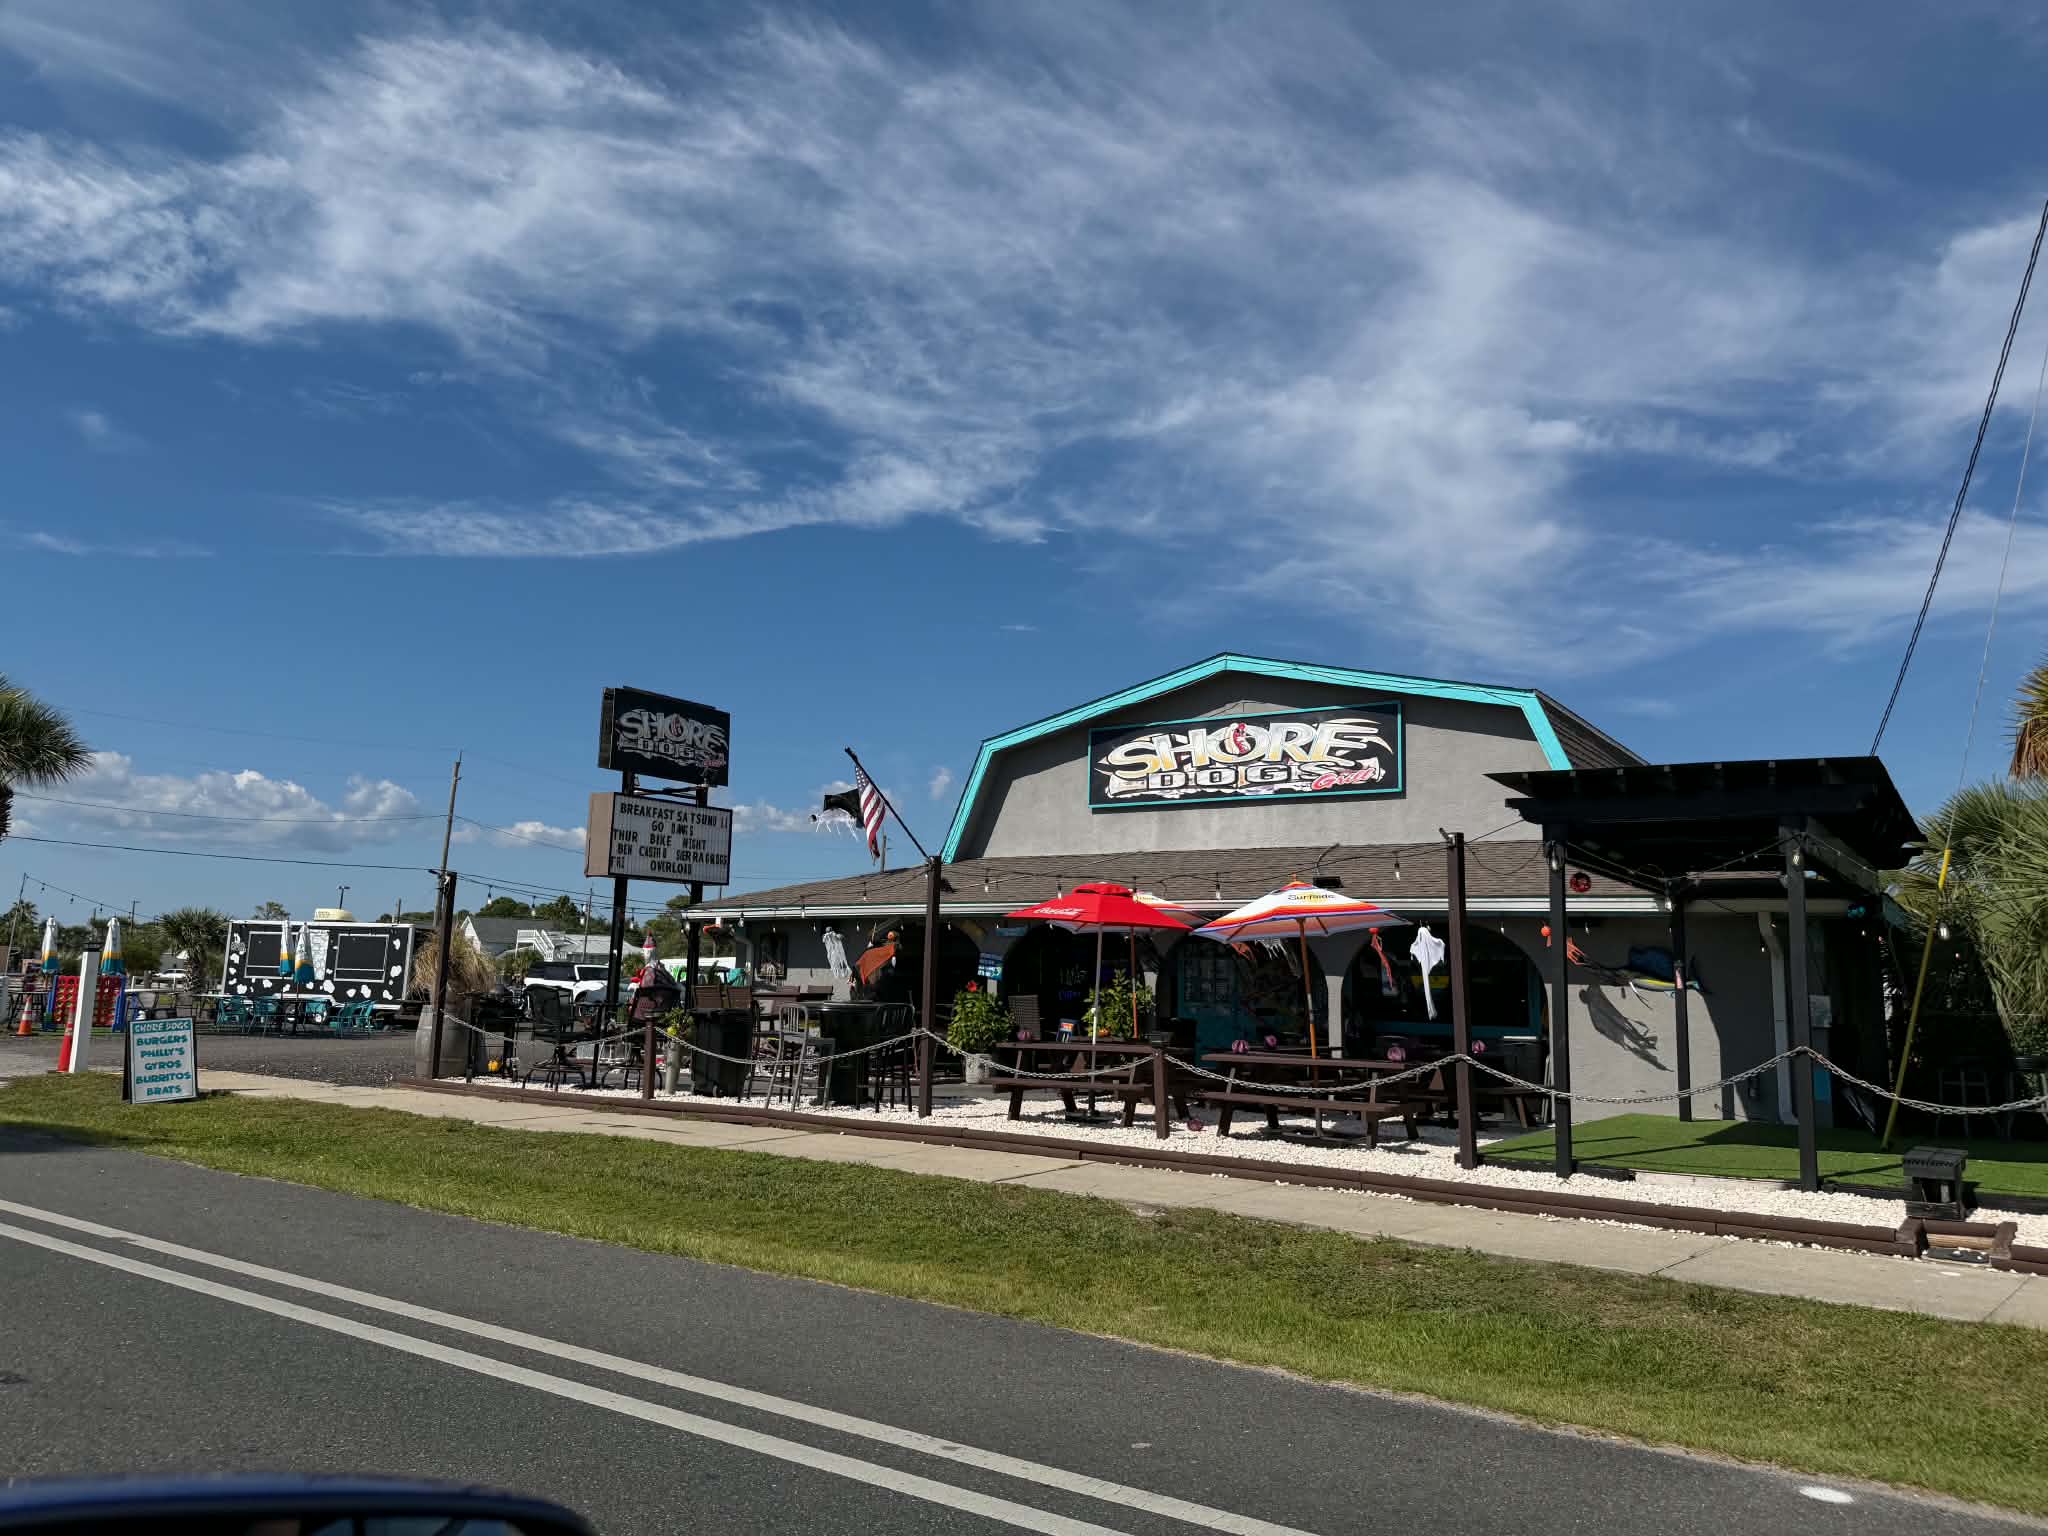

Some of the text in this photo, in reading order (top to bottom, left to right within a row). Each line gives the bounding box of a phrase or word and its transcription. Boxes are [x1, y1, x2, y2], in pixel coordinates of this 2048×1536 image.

[617, 708, 728, 752] SHORE
[1098, 719, 1393, 778] SHORE
[1148, 761, 1376, 791] DOGS Grill
[620, 802, 675, 820] BREAKFAST
[651, 820, 664, 833] GO
[613, 829, 706, 851] THUR BIKE NIGHT
[136, 1035, 188, 1046] BURGERS
[140, 1047, 185, 1058] PHILLY'S
[144, 1060, 182, 1070] GYROS
[135, 1071, 192, 1084] BURRITOS
[146, 1085, 182, 1096] BRATS
